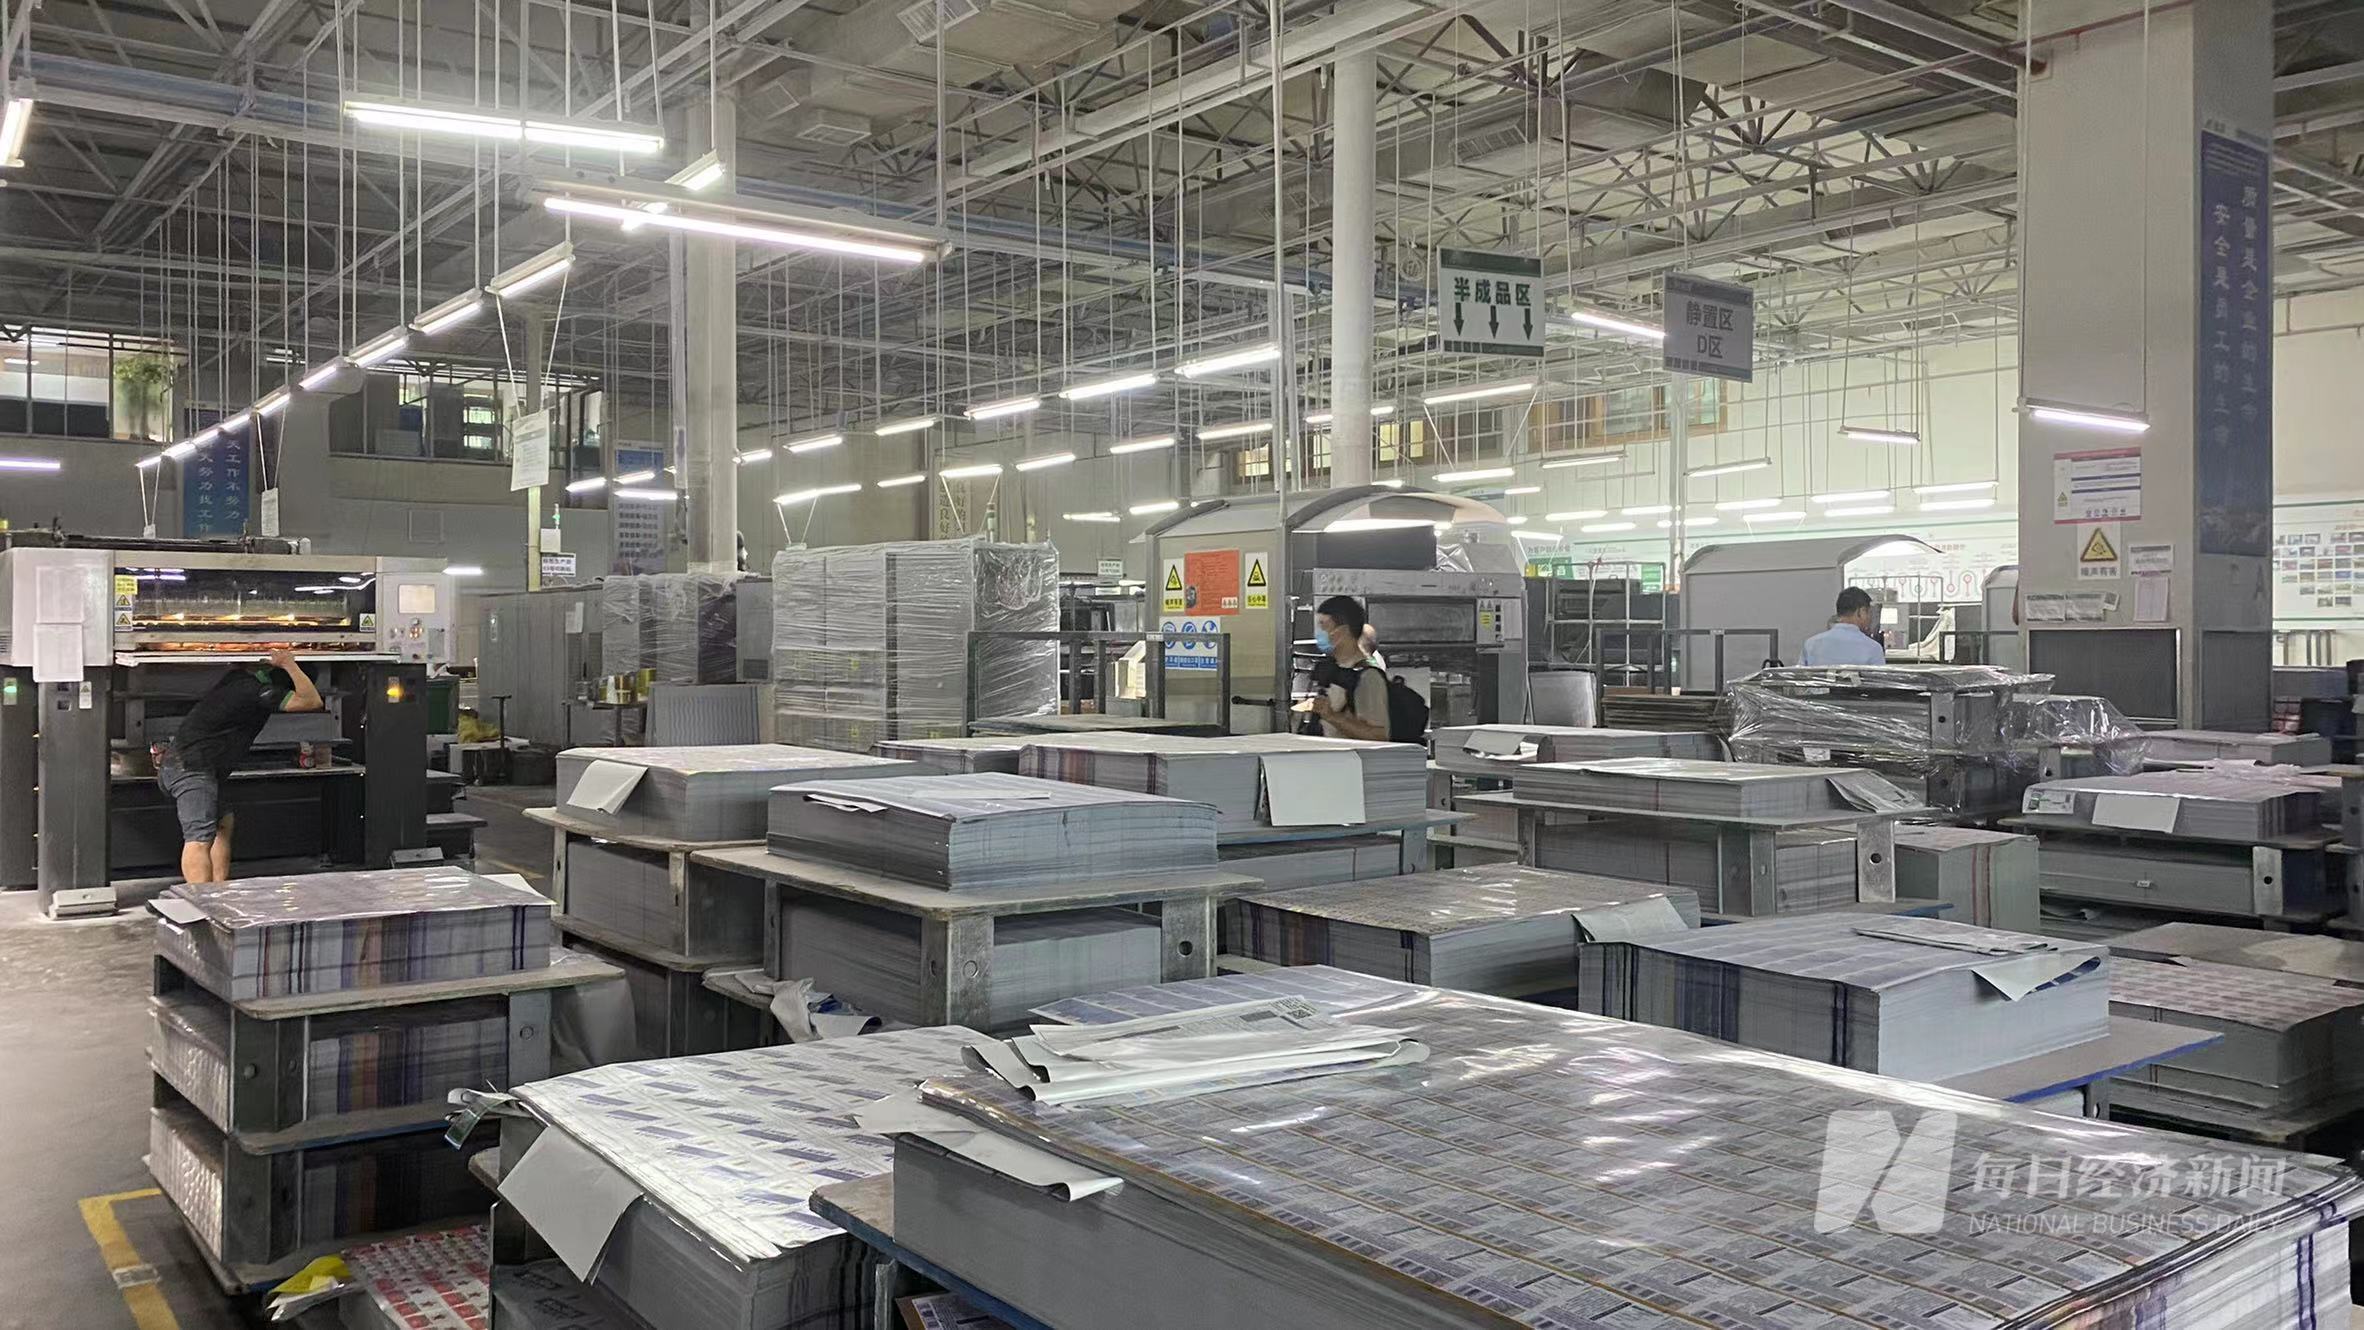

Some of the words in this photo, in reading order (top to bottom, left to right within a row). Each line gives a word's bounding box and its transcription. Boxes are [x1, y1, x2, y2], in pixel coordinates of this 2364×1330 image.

[1454, 277, 1531, 306] 半成品区
[1687, 300, 1734, 331] 静置区
[1698, 335, 1724, 358] D区
[225, 438, 241, 519] 天工作不努力
